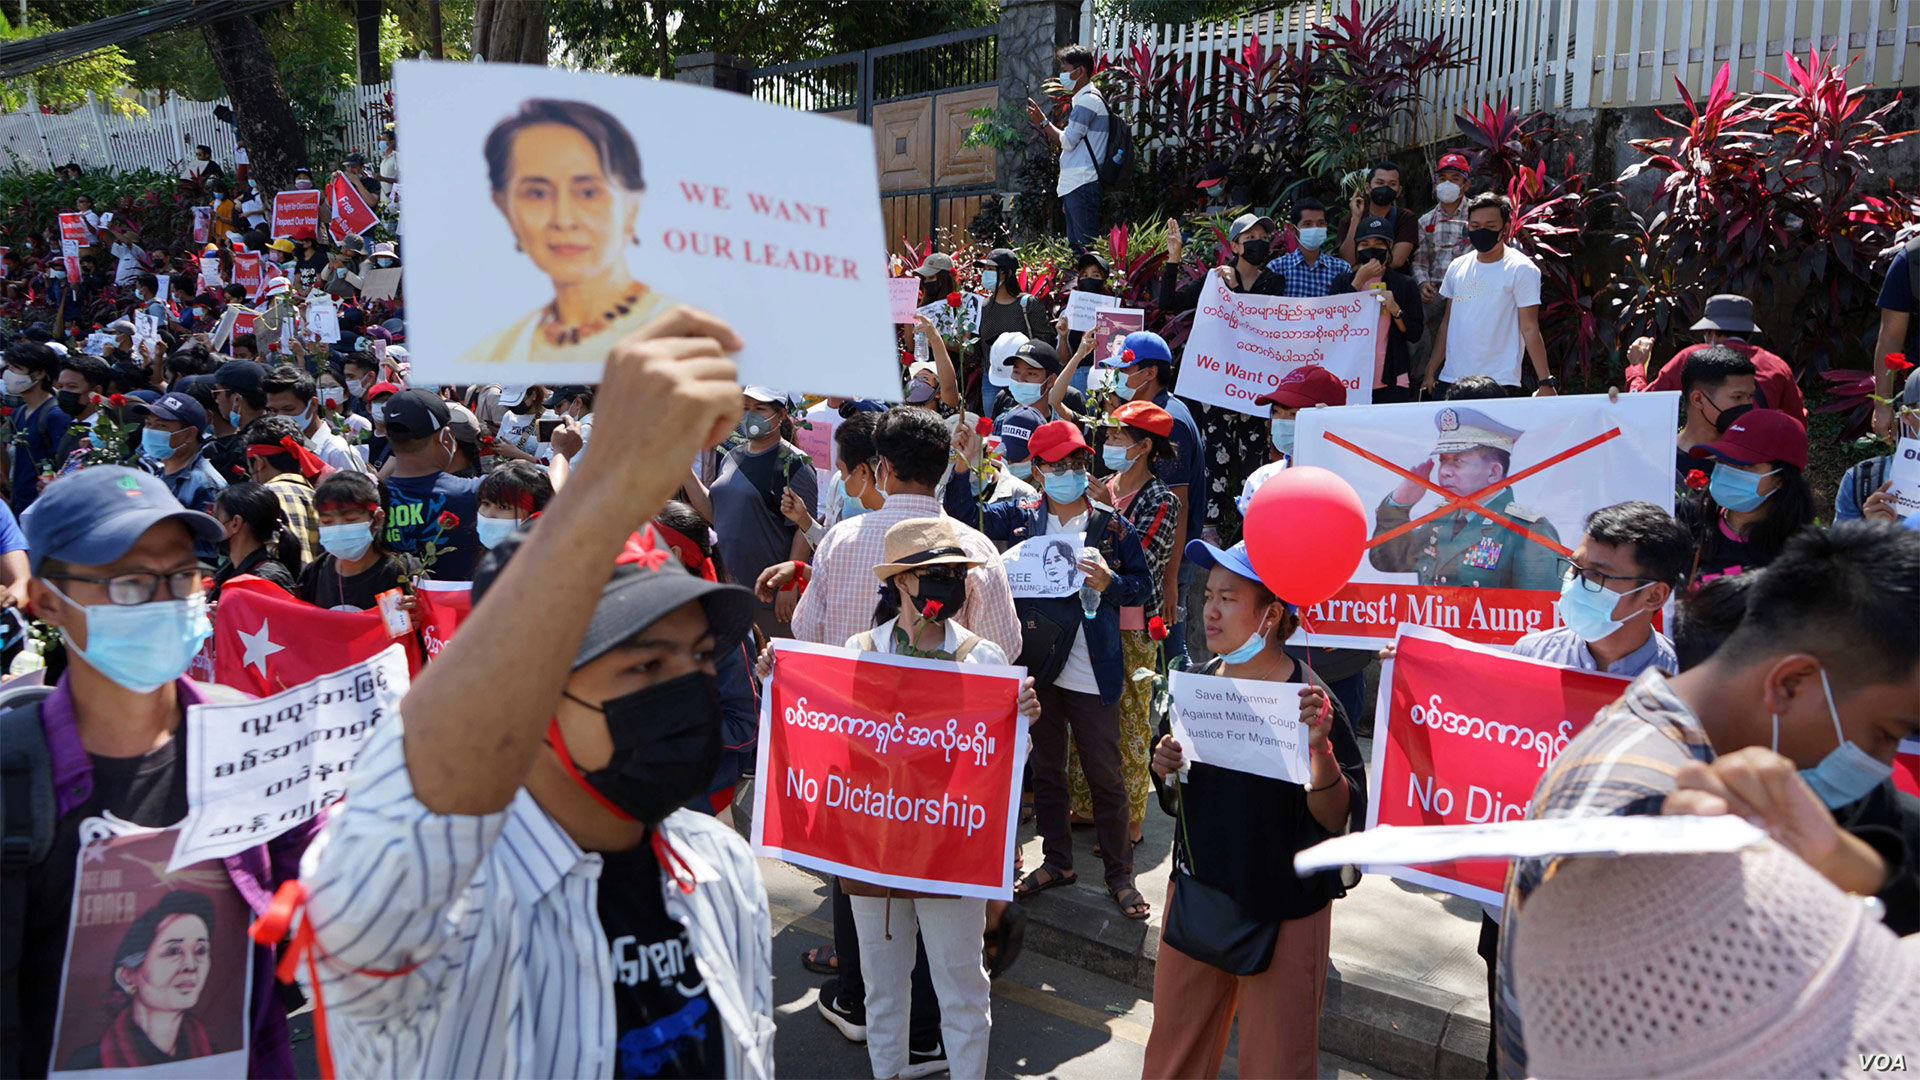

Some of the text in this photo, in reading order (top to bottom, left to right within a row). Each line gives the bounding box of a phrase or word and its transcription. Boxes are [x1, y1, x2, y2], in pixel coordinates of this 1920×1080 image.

[679, 181, 829, 229] WE WANT
[295, 216, 304, 226] Our
[662, 228, 860, 281] OUR LEADER
[235, 323, 254, 334] Save
[1197, 354, 1220, 371] We
[1225, 361, 1263, 383] Want
[1307, 592, 1397, 626] Arrest!
[1406, 593, 1460, 628] Min
[1467, 596, 1542, 633] Aung
[1195, 688, 1279, 705] Save Myanmar
[1182, 708, 1297, 730] Against Military Coup
[1186, 728, 1297, 751] Justice For Myanmar
[786, 766, 987, 837] No Dictatorship
[1407, 772, 1454, 816] No
